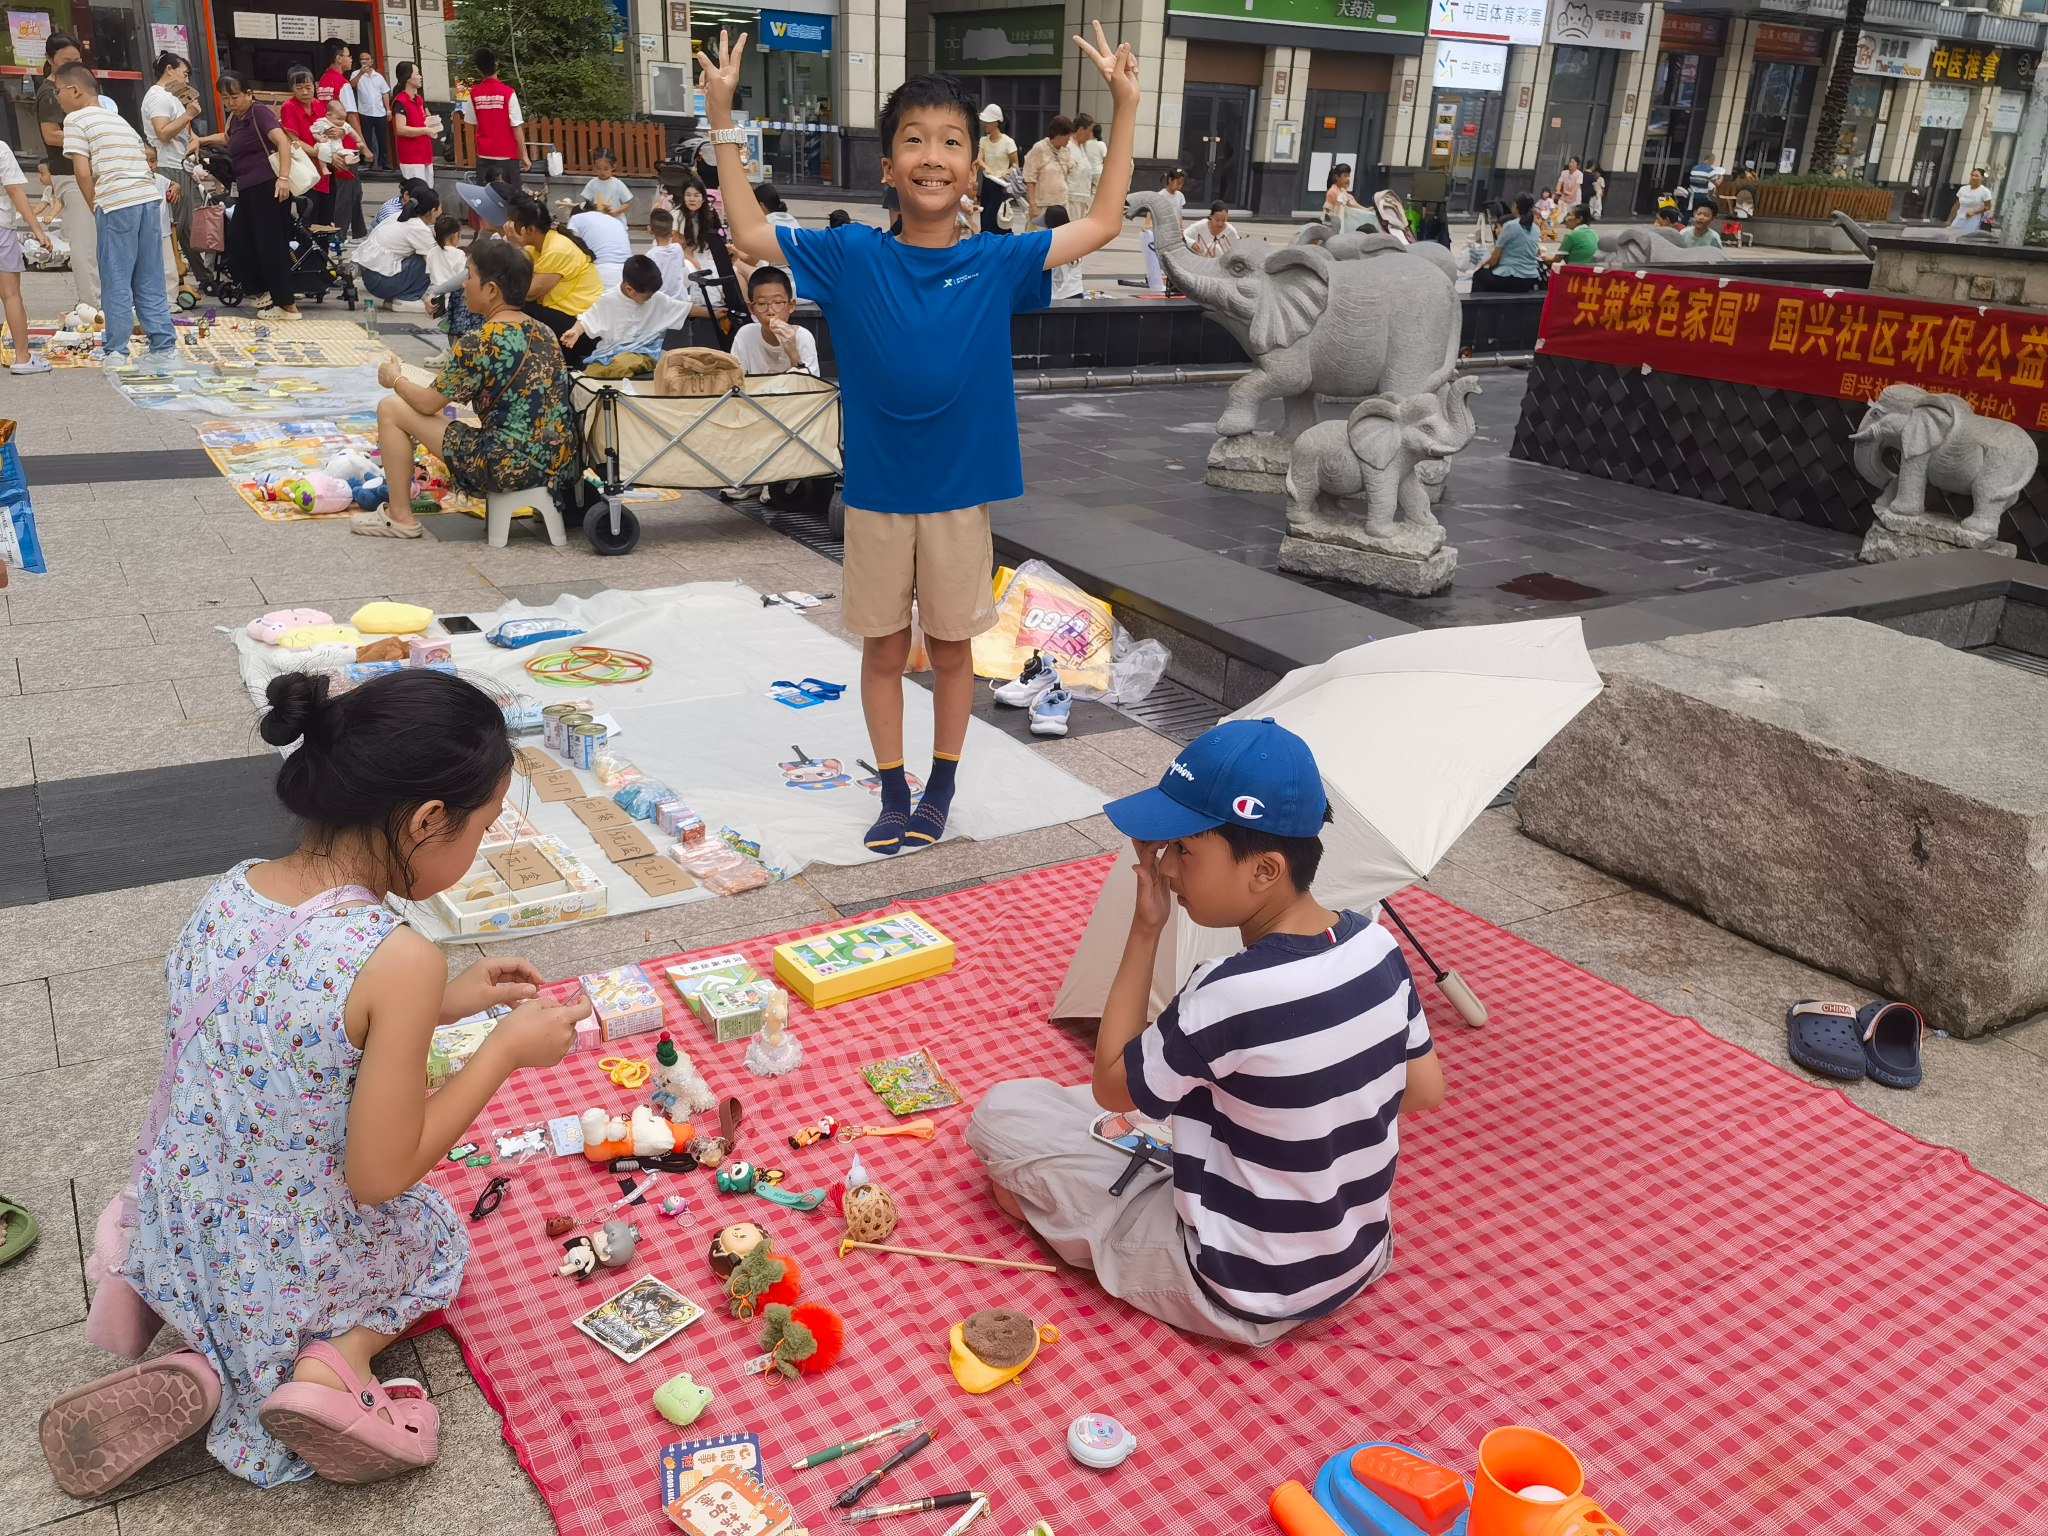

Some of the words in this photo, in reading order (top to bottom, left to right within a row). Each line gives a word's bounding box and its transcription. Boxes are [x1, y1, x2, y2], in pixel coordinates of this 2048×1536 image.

[1336, 0, 1375, 19] 大药房
[1462, 1, 1543, 27] 中国体育彩票
[1461, 61, 1503, 77] 中国体彩
[1932, 45, 2000, 83] 中医推拿
[1769, 298, 2048, 388] 固兴社区环保公益
[1840, 372, 2017, 421] 固兴社务中心
[1822, 1003, 1851, 1014] CHINA
[666, 1469, 675, 1489] GOOD
